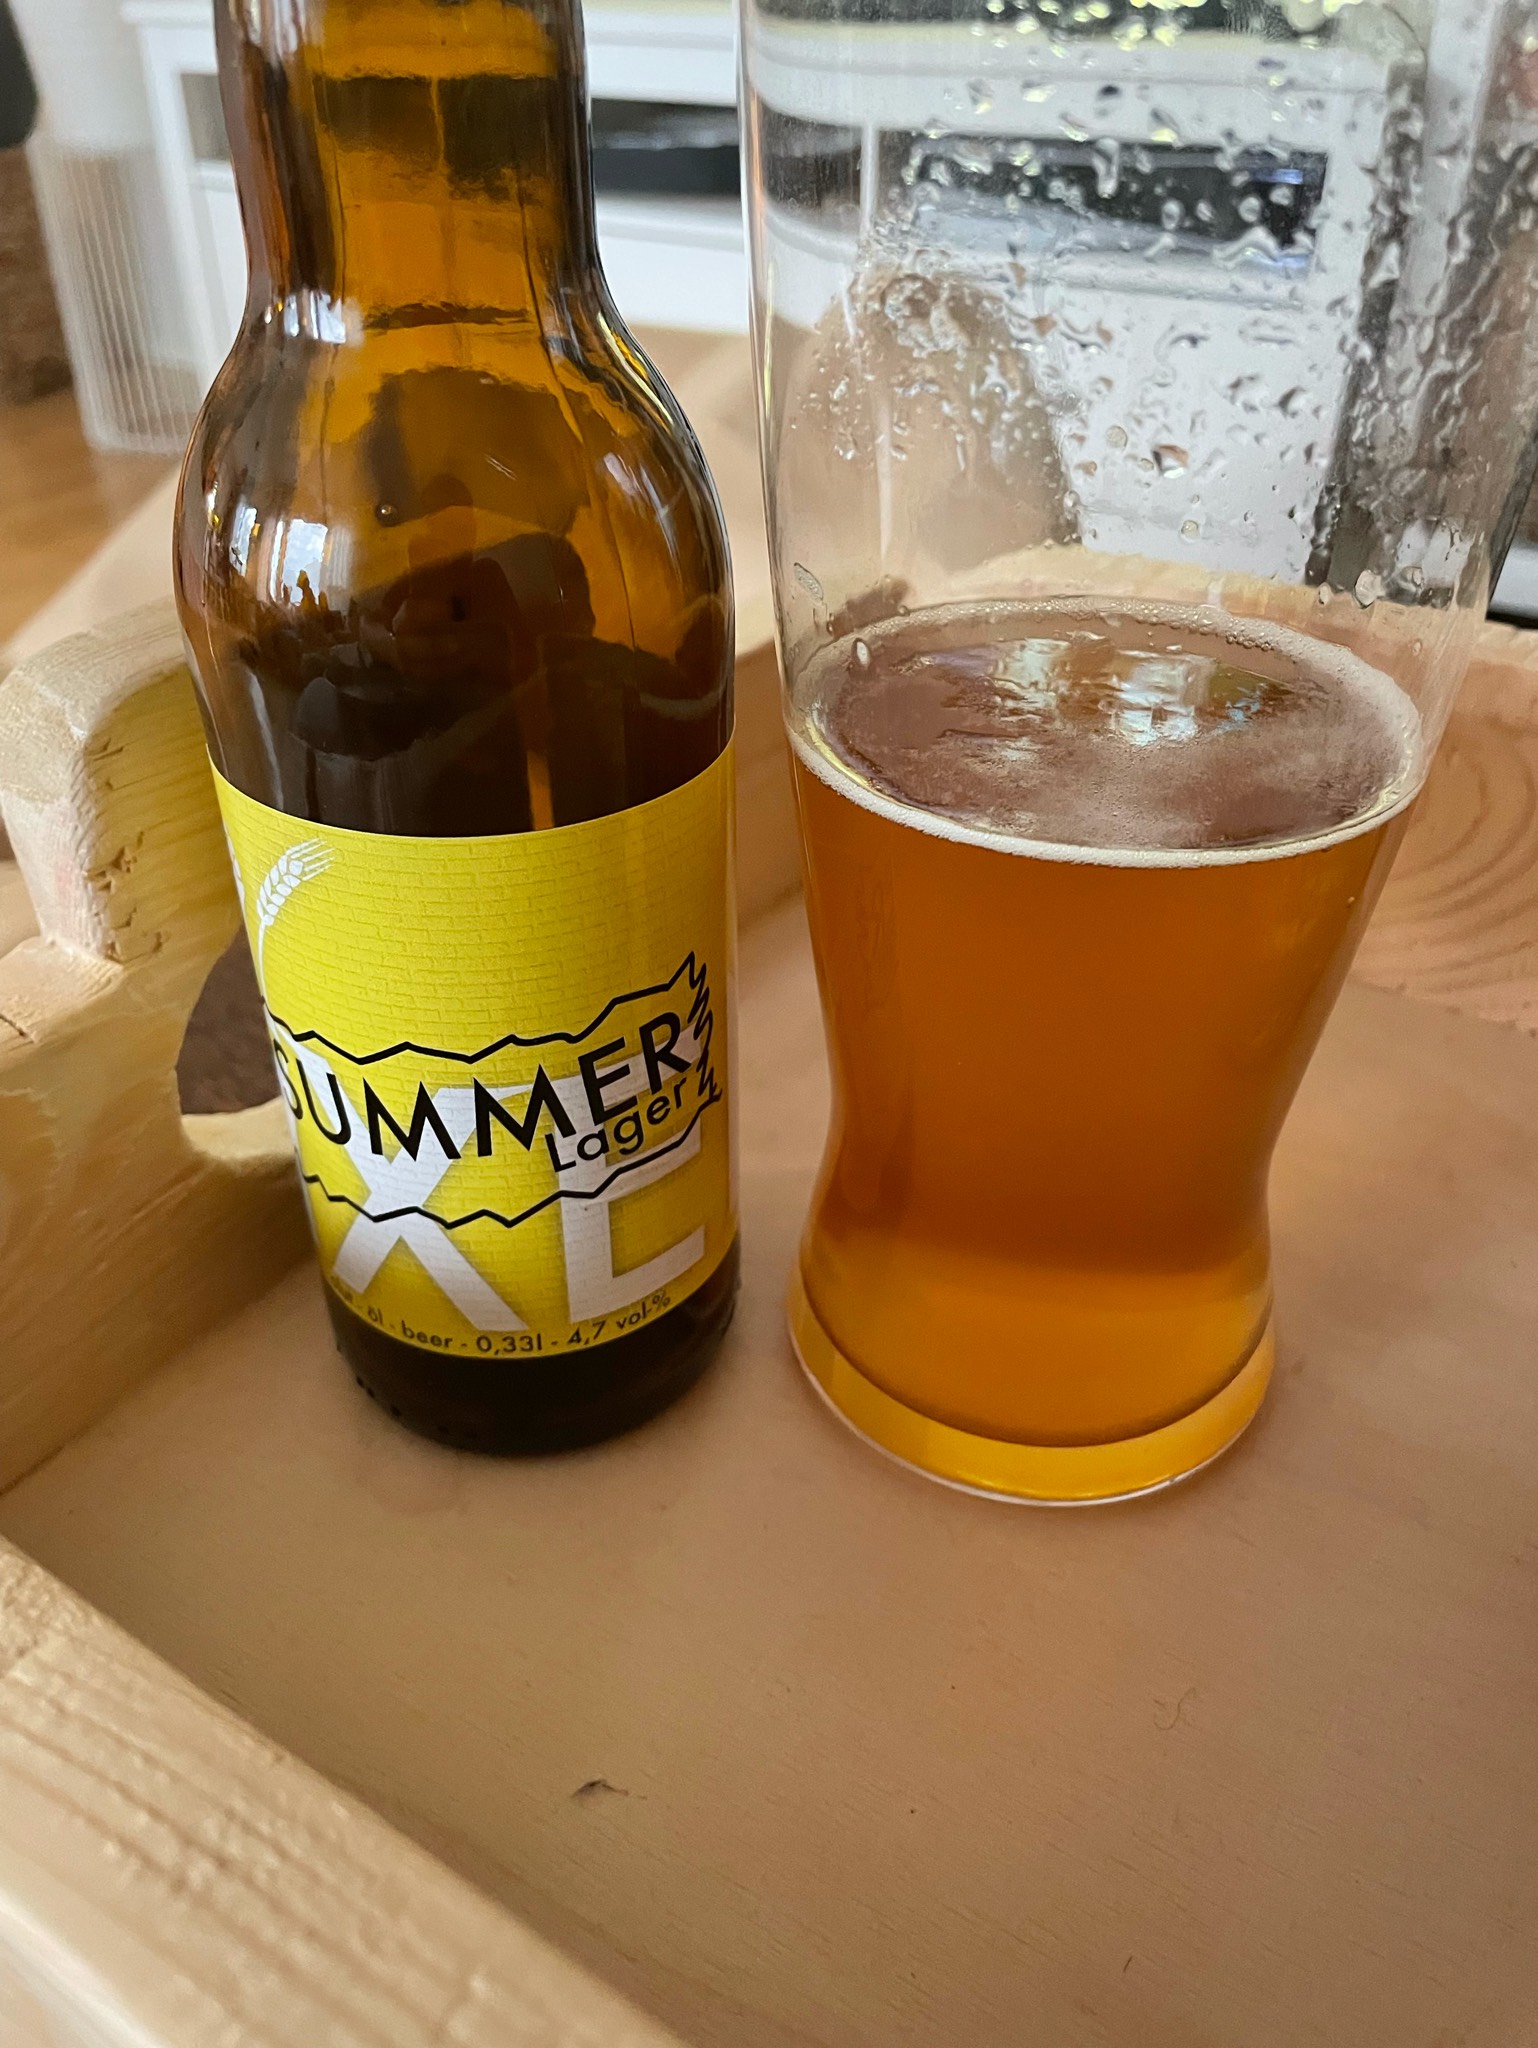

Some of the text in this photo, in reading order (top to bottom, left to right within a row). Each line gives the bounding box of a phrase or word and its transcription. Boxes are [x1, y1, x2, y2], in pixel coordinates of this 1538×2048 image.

[274, 1011, 691, 1161] SUMMER
[545, 1075, 687, 1172] Lager
[401, 1320, 453, 1350] beer
[476, 1332, 544, 1357] 0,33l
[566, 1321, 607, 1347] 4,7
